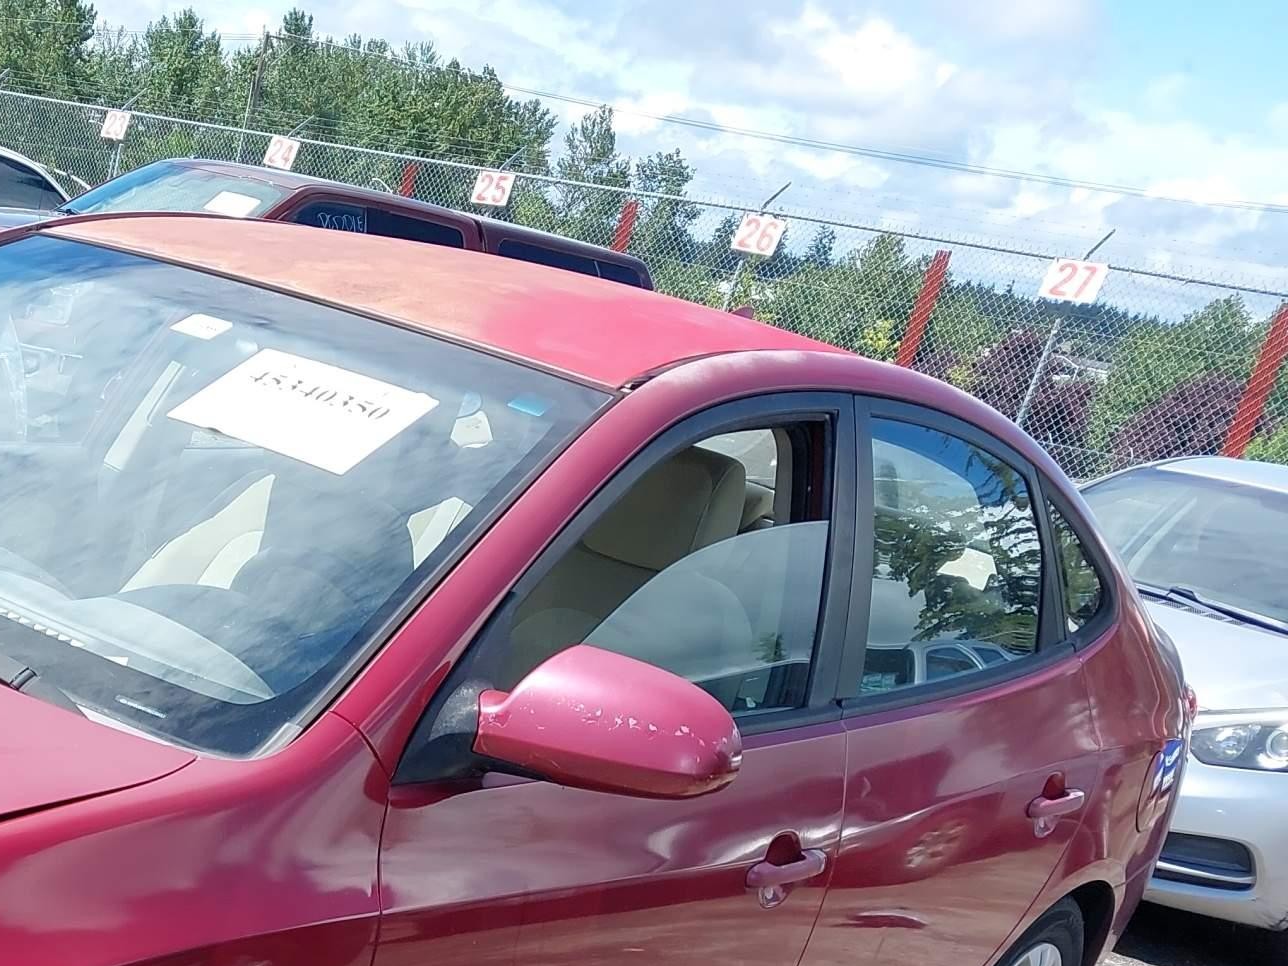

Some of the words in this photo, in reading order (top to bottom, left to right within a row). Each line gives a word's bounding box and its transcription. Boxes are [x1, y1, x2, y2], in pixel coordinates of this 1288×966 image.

[105, 112, 127, 137] 23
[268, 139, 294, 168] 24
[475, 173, 509, 204] 25
[736, 217, 778, 252] 26
[1048, 262, 1098, 299] 27
[249, 371, 391, 420] 45340350
